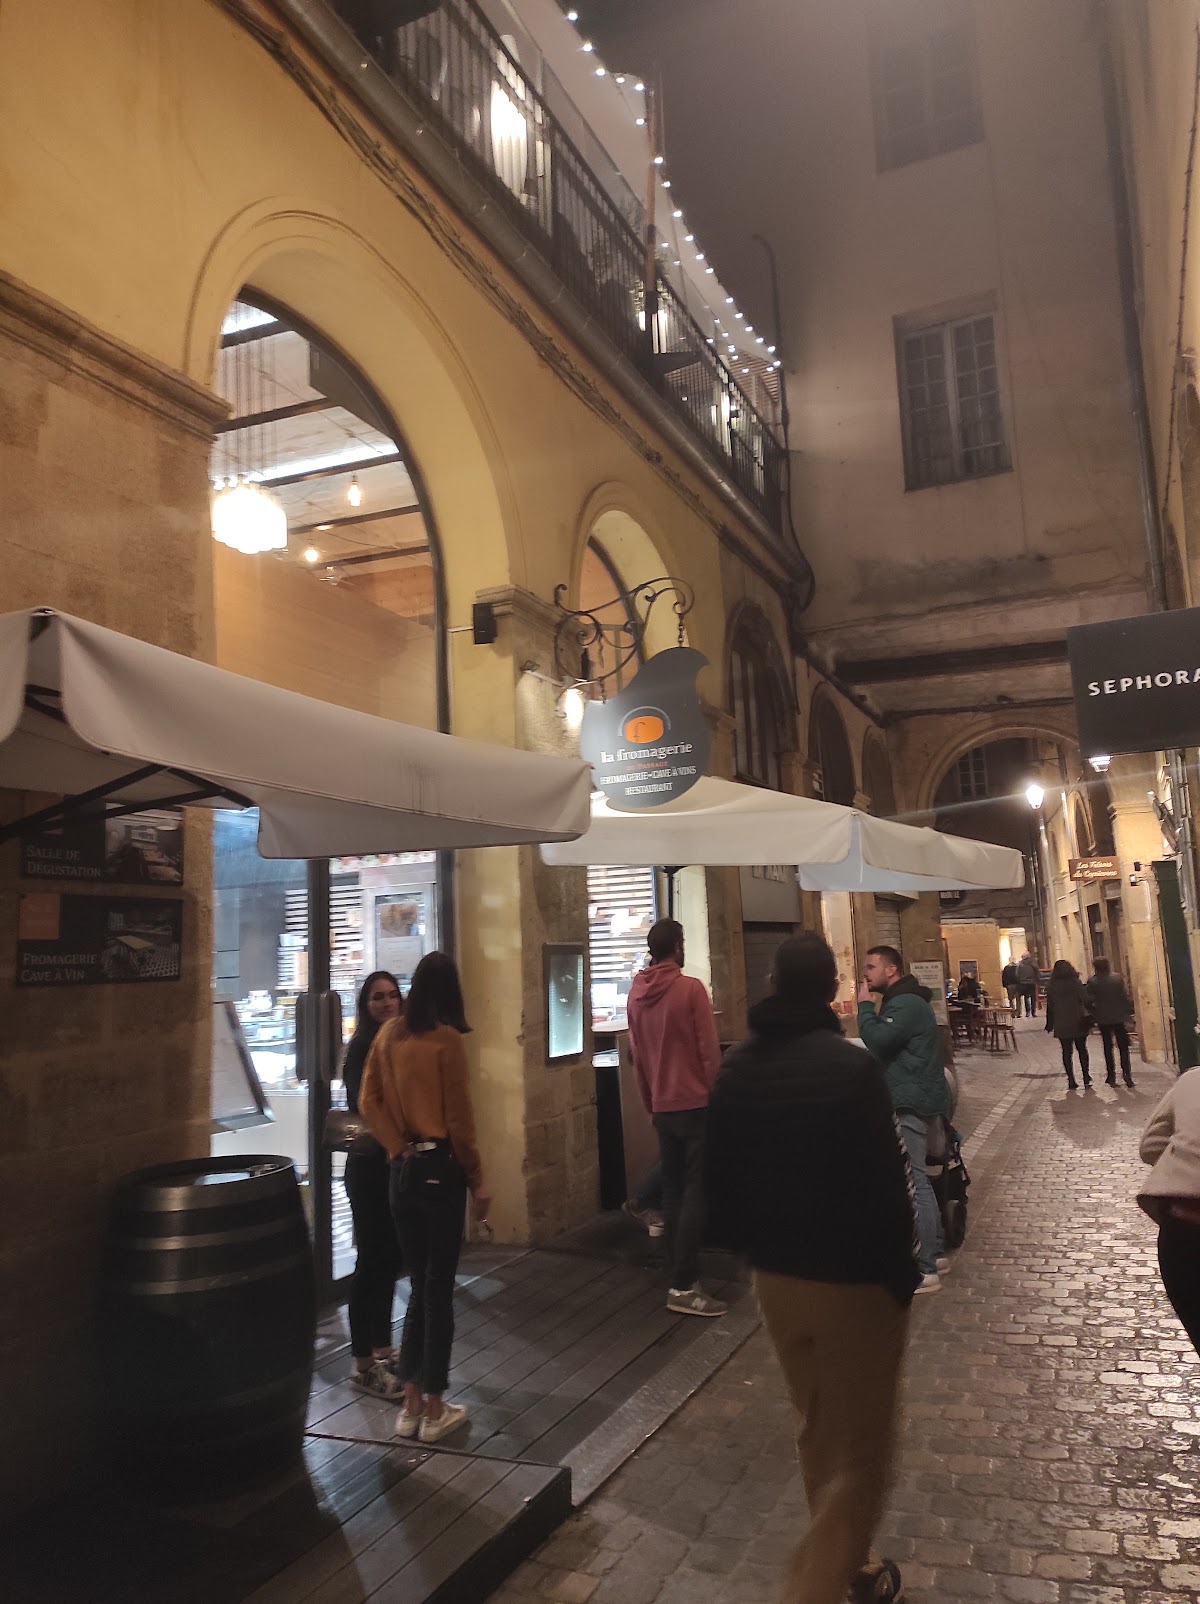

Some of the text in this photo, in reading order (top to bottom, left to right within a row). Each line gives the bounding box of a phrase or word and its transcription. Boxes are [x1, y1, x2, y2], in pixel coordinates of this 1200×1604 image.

[600, 741, 693, 763] la fromagerie
[624, 782, 674, 796] RESTAURANT
[23, 952, 97, 966] FROMAGERIE
[21, 969, 52, 982] CAVE
[64, 968, 86, 980] VIN
